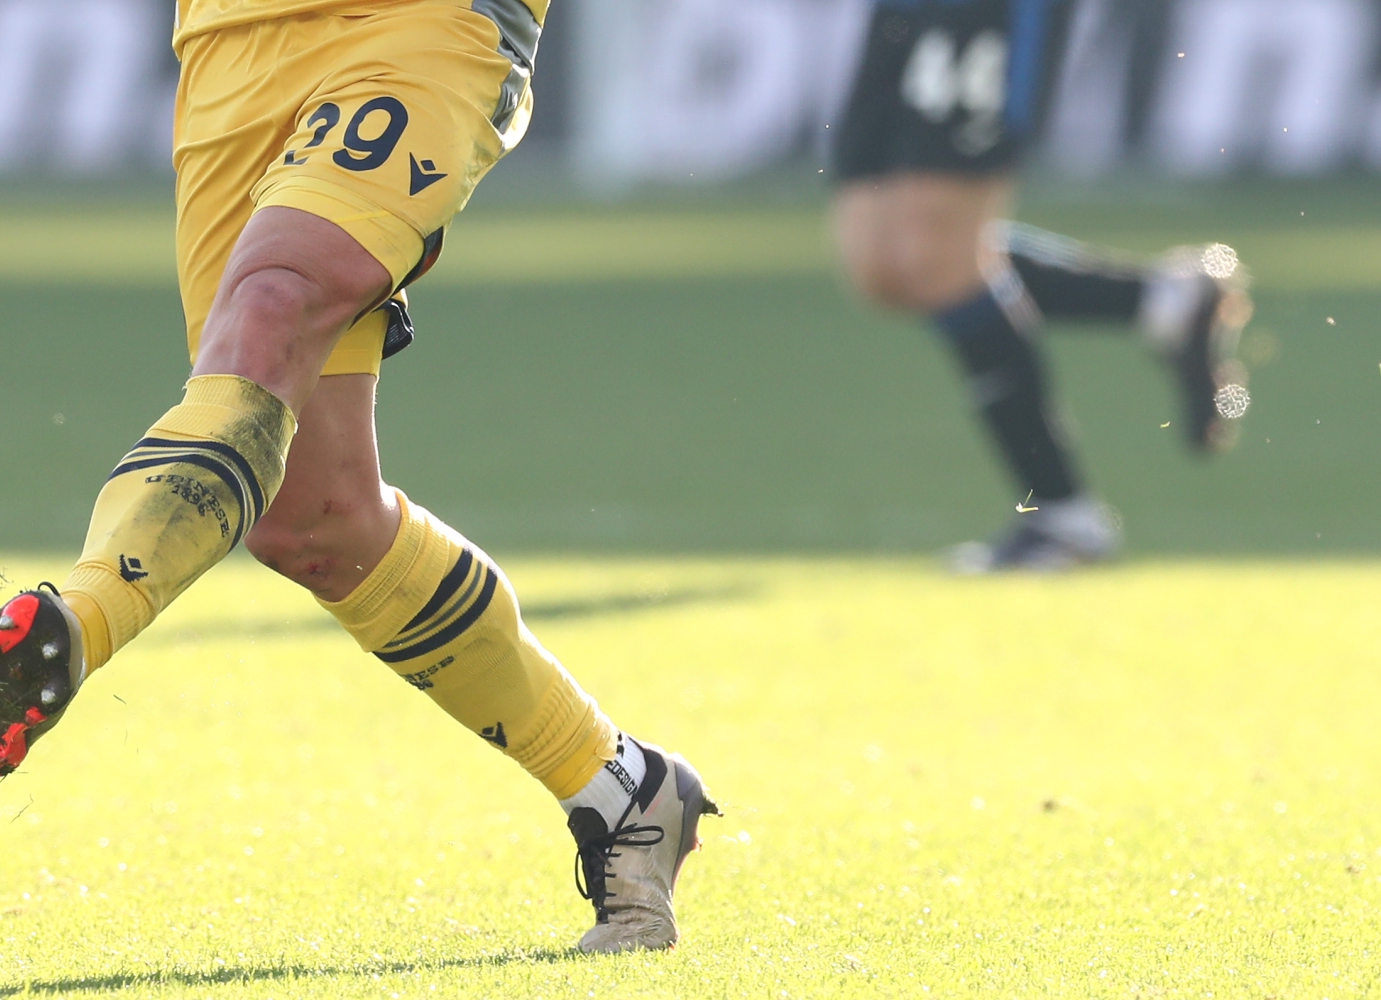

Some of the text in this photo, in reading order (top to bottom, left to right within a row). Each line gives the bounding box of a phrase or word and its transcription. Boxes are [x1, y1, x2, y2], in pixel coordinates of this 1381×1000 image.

[899, 27, 1009, 123] 44
[282, 96, 409, 172] 29
[145, 474, 230, 537] UDINESE
[172, 484, 208, 517] 1896
